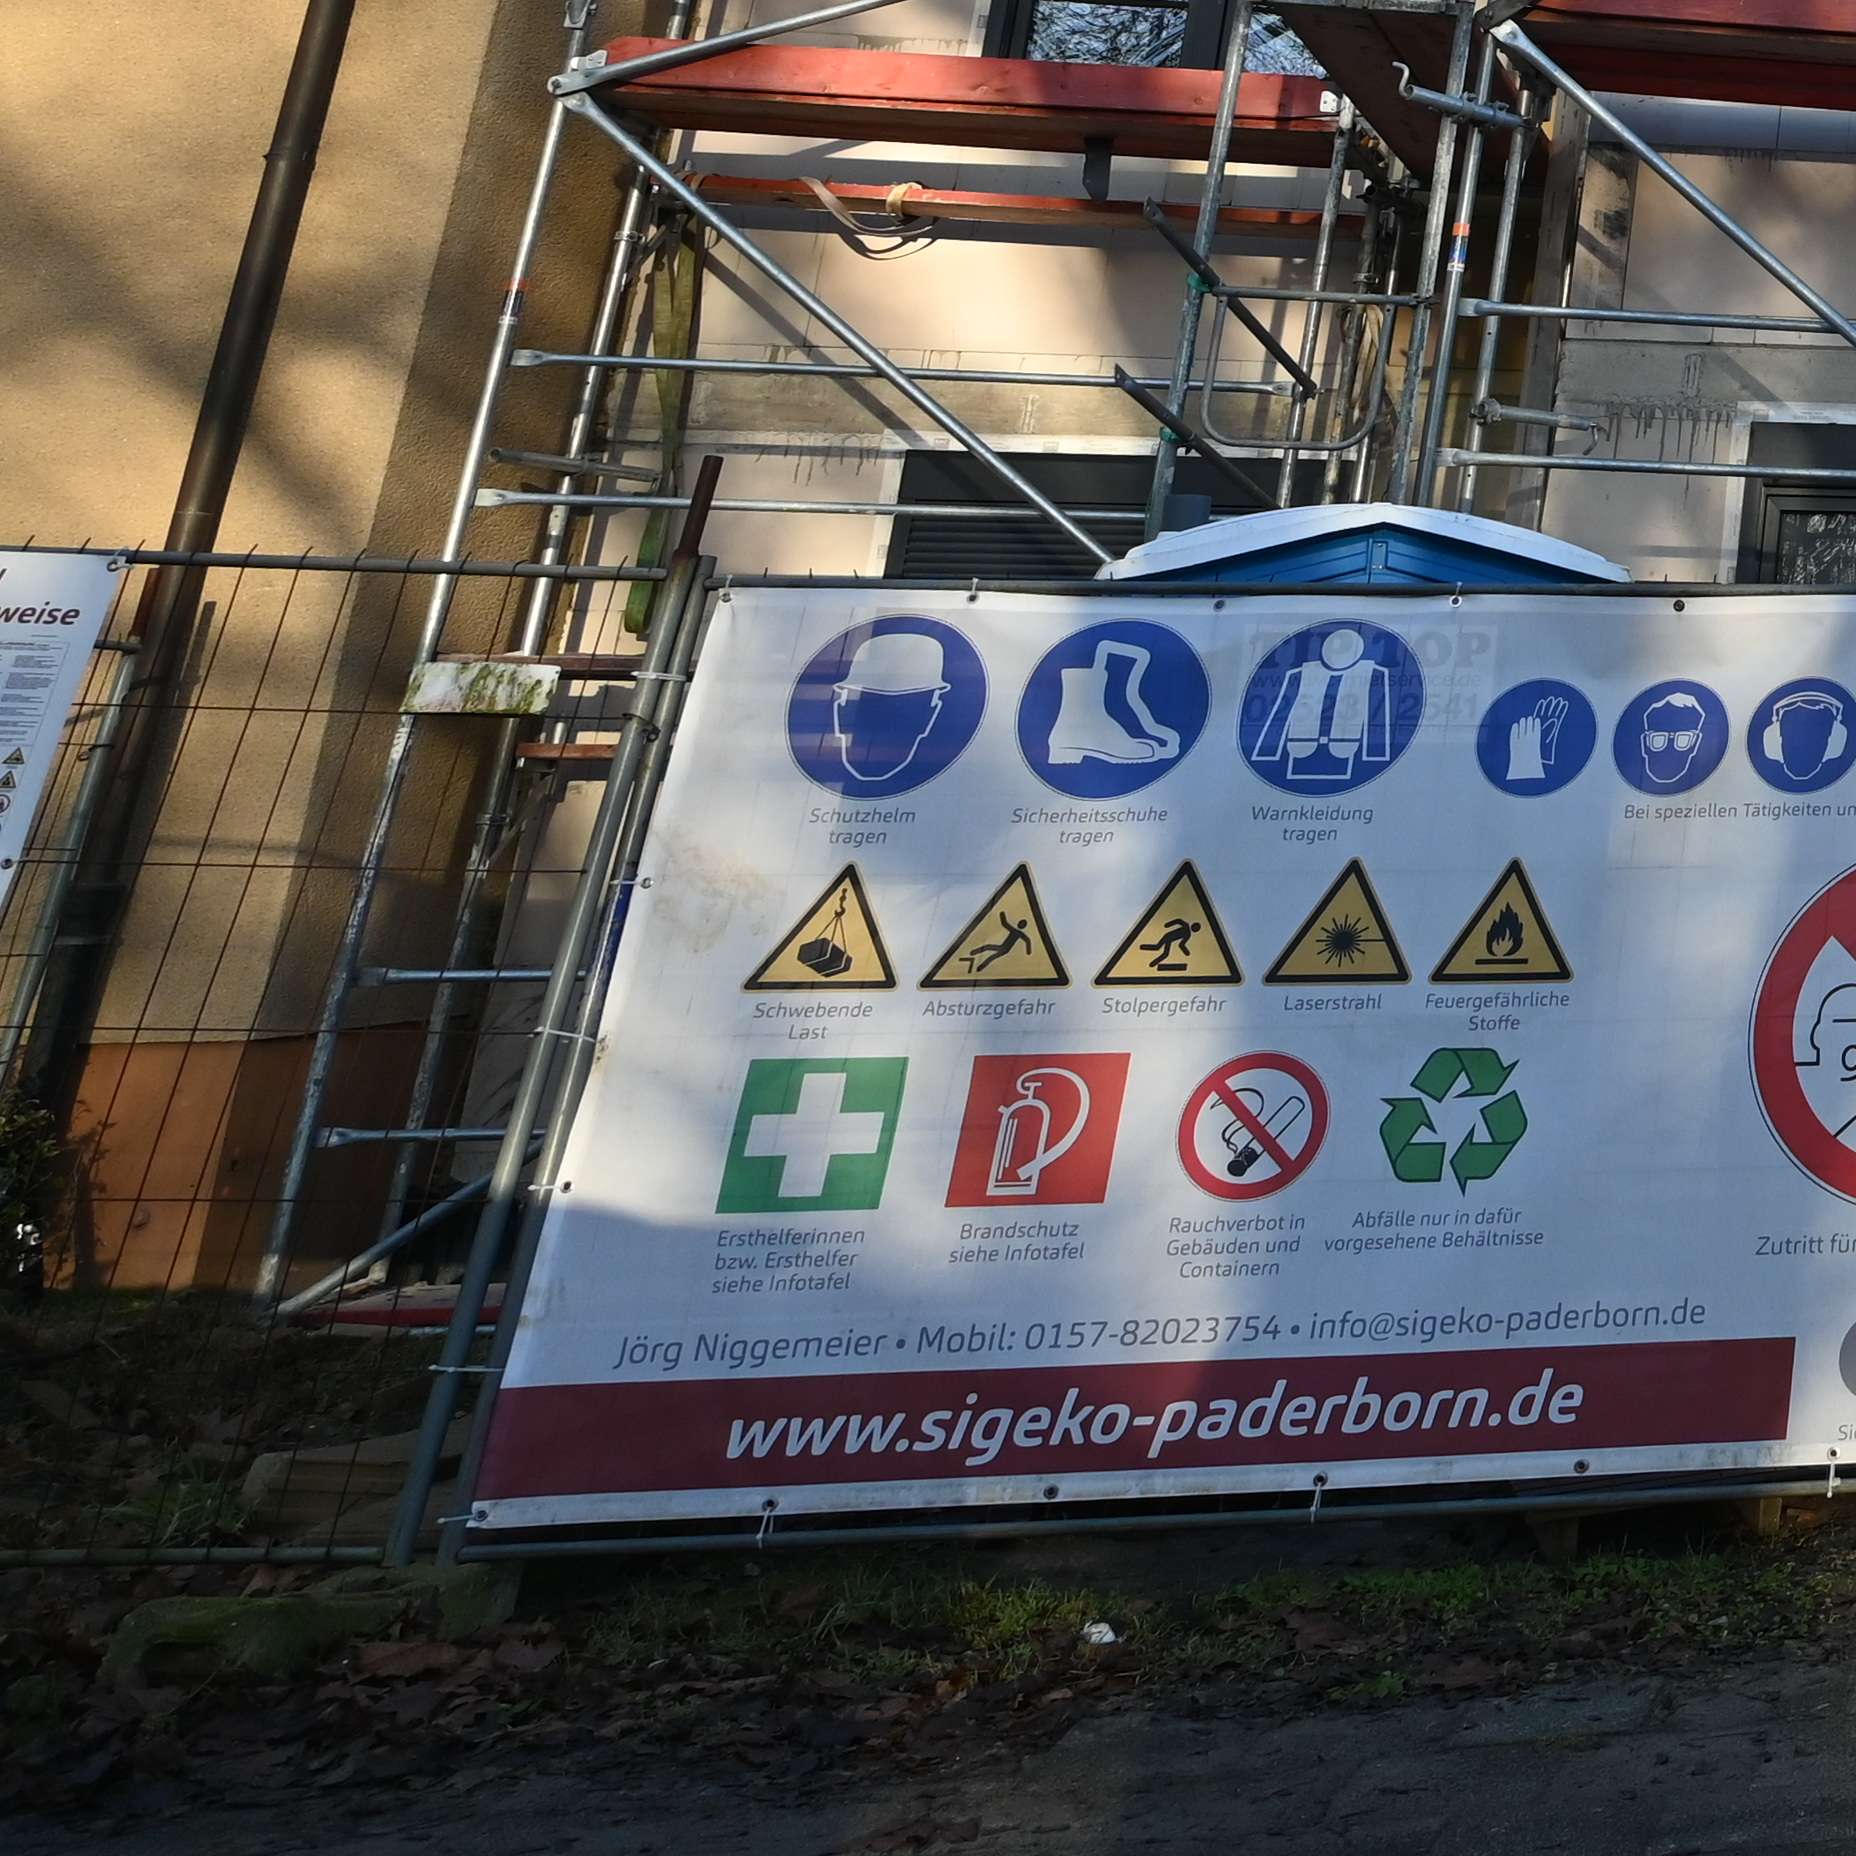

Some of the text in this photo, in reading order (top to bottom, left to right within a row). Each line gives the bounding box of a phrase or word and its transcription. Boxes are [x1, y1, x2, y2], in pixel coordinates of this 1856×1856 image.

[809, 807, 917, 825] Schutzhelm
[1011, 806, 1168, 825] Sicherheitsschuhe
[1251, 805, 1374, 827] Warnkleidung
[1624, 804, 1650, 819] Bei
[1654, 803, 1738, 822] speziellen
[1743, 802, 1832, 821] Tätigkeiten
[828, 830, 888, 847] tragen
[1059, 830, 1114, 846] tragen
[1282, 827, 1338, 846] tragen
[753, 1002, 874, 1020] Schwebende
[922, 998, 1057, 1020] Absturzgefahr
[1102, 996, 1227, 1017] Stolpergefahr
[1284, 993, 1383, 1012] Laserstrahl
[1425, 991, 1571, 1013] Feuergefährliche
[788, 1024, 827, 1041] Last
[1468, 1015, 1521, 1032] Stoffe
[1169, 1214, 1306, 1234] Rauchverbot in
[1351, 1207, 1522, 1229] Abfälle nur in dafür
[717, 1228, 865, 1248] Ersthelferinnen
[960, 1220, 1080, 1241] Brandschutz
[1166, 1235, 1301, 1257] Gebäuden und
[1324, 1229, 1544, 1255] vorgesehene Behältnisse
[1754, 1233, 1824, 1256] Zutritt
[714, 1249, 859, 1271] bzw. Ersthelfer
[948, 1242, 1085, 1264] siehe Infotafel
[1179, 1259, 1280, 1279] Containern
[712, 1272, 851, 1294] siehe Infotafel
[613, 1297, 1706, 1371] Jörg Niggemeier Mobil: 0157-82023754 info@sigeko-paderborn.de
[724, 1368, 1585, 1467] www.sigeko-paderborn.de
